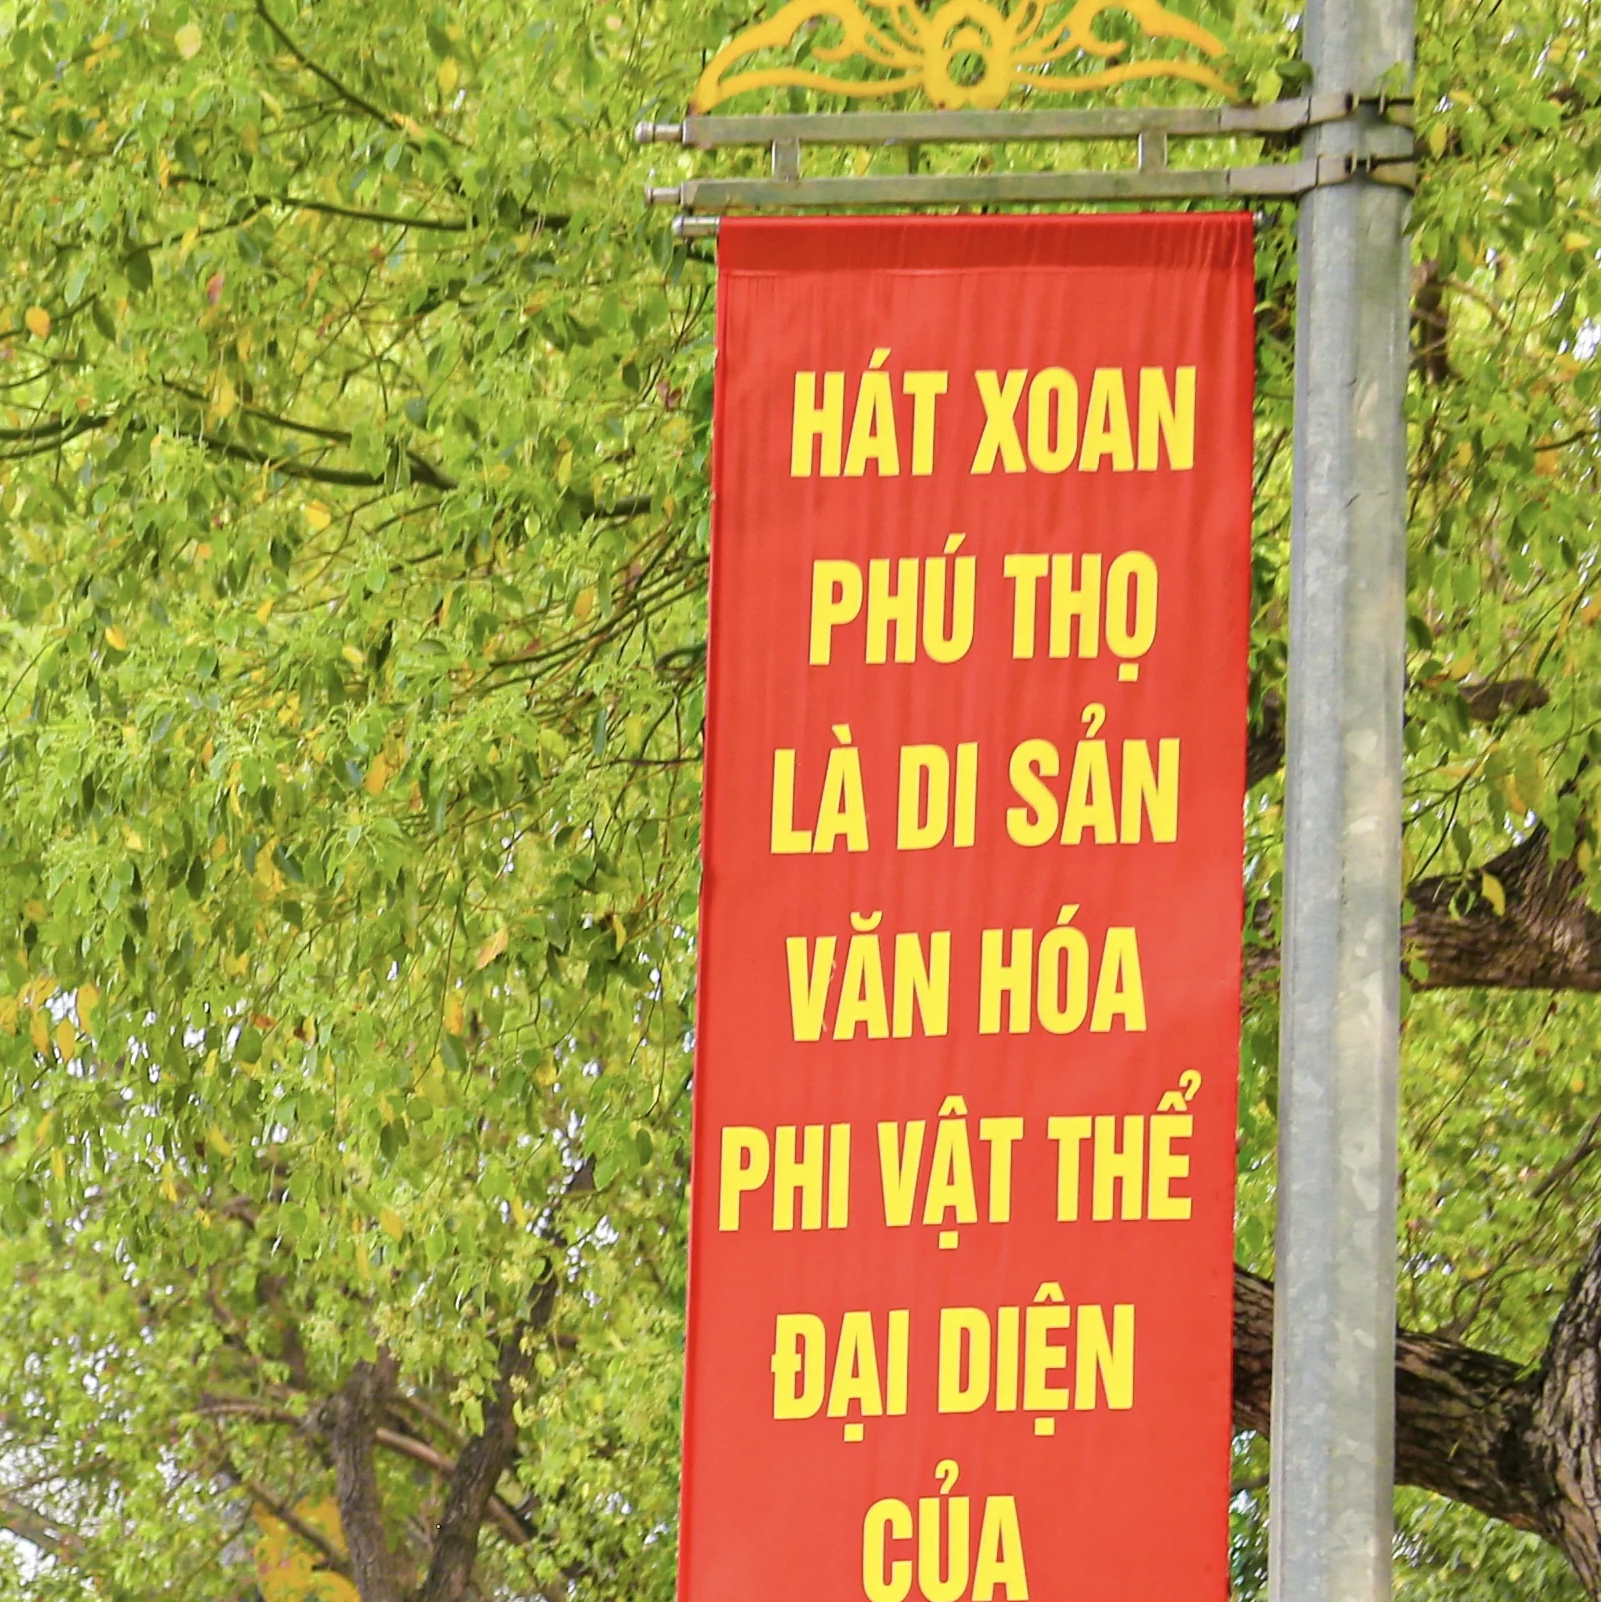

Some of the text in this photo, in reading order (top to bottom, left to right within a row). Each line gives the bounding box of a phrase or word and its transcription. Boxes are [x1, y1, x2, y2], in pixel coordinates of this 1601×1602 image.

[790, 347, 1197, 478] HÁT XOAN
[809, 532, 1159, 682] PHÚ THỌ
[770, 702, 1180, 854] LÀ DI SẢN
[786, 903, 1147, 1042] VĂN HÓA
[718, 1069, 1202, 1250] PHI VẬT THỂ
[770, 1281, 1135, 1442] ĐẠI DIỆN
